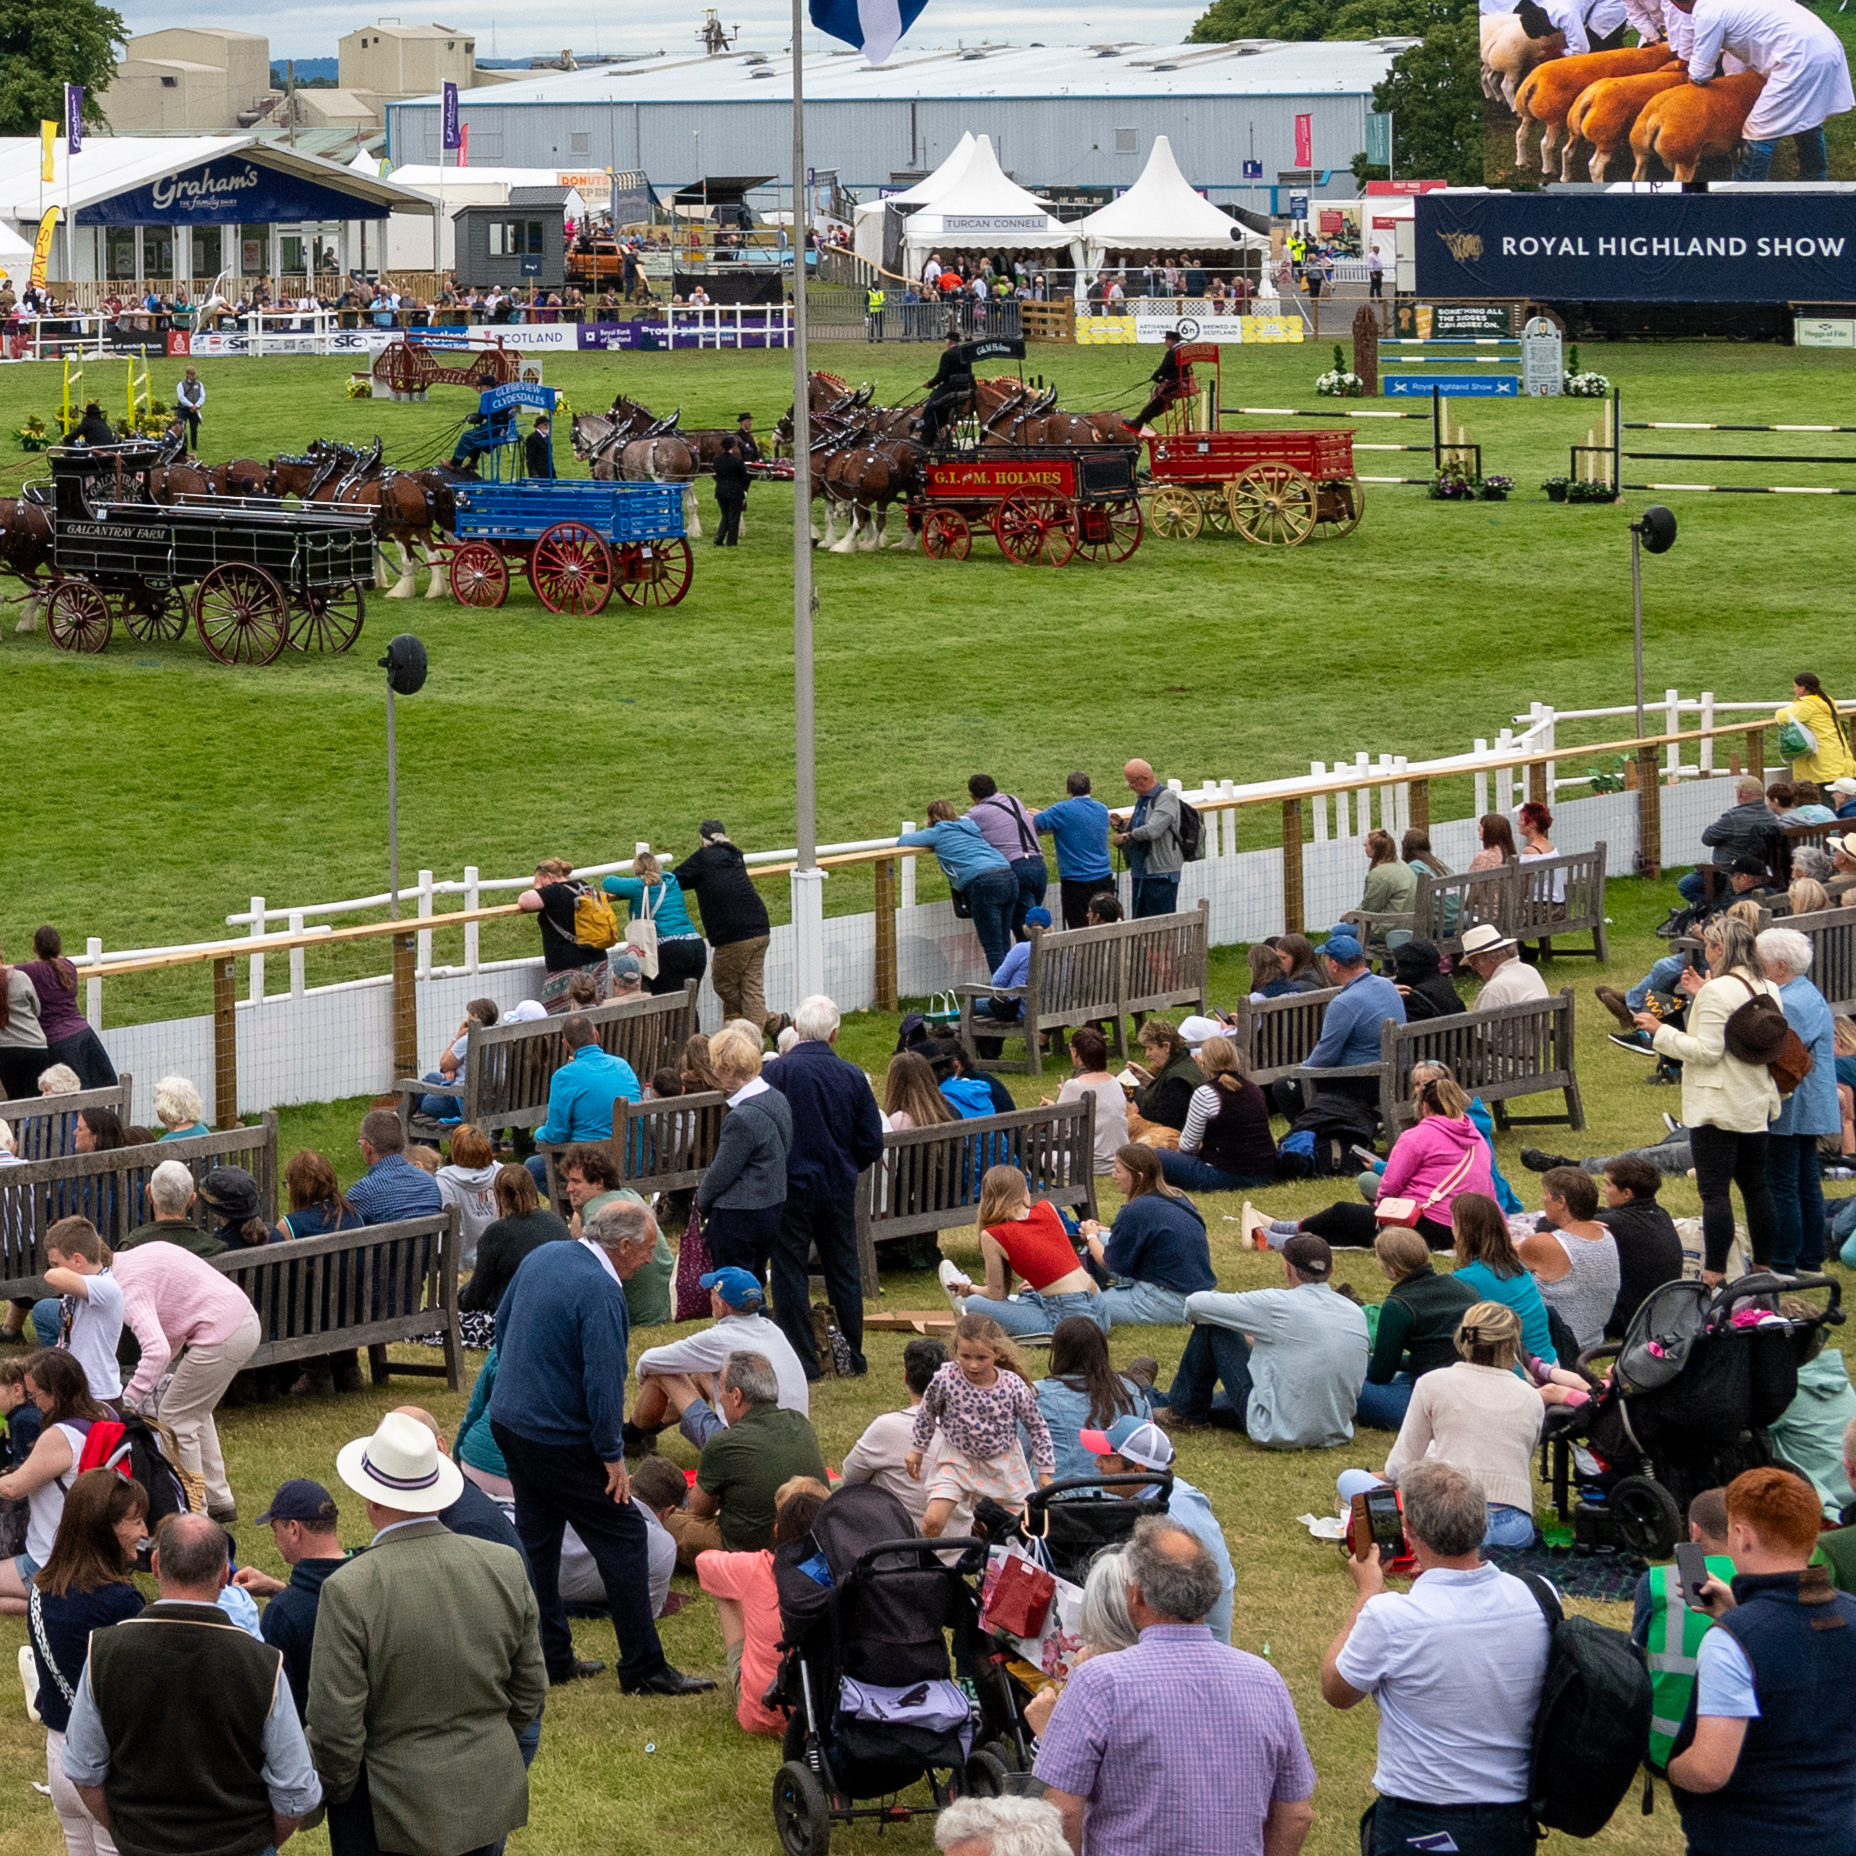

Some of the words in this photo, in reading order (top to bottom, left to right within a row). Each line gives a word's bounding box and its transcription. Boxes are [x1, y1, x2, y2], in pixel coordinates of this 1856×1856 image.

[152, 165, 258, 209] Graham's
[561, 176, 609, 186] DONUTS
[946, 219, 991, 228] TURCAN
[994, 219, 1045, 228] CONNELL
[1501, 237, 1590, 256] ROYAL
[1598, 237, 1748, 256] HIGHLAND
[1756, 237, 1846, 256] SHOW
[600, 329, 616, 337] Royal
[333, 334, 363, 348] STC
[495, 383, 542, 397] GLEBEVIEW
[492, 392, 546, 410] CLYDESDALES
[995, 471, 1063, 484] HOLMES
[90, 473, 142, 497] GALCATRAY
[67, 524, 136, 538] GALCANTRAY
[136, 529, 166, 540] FARM
